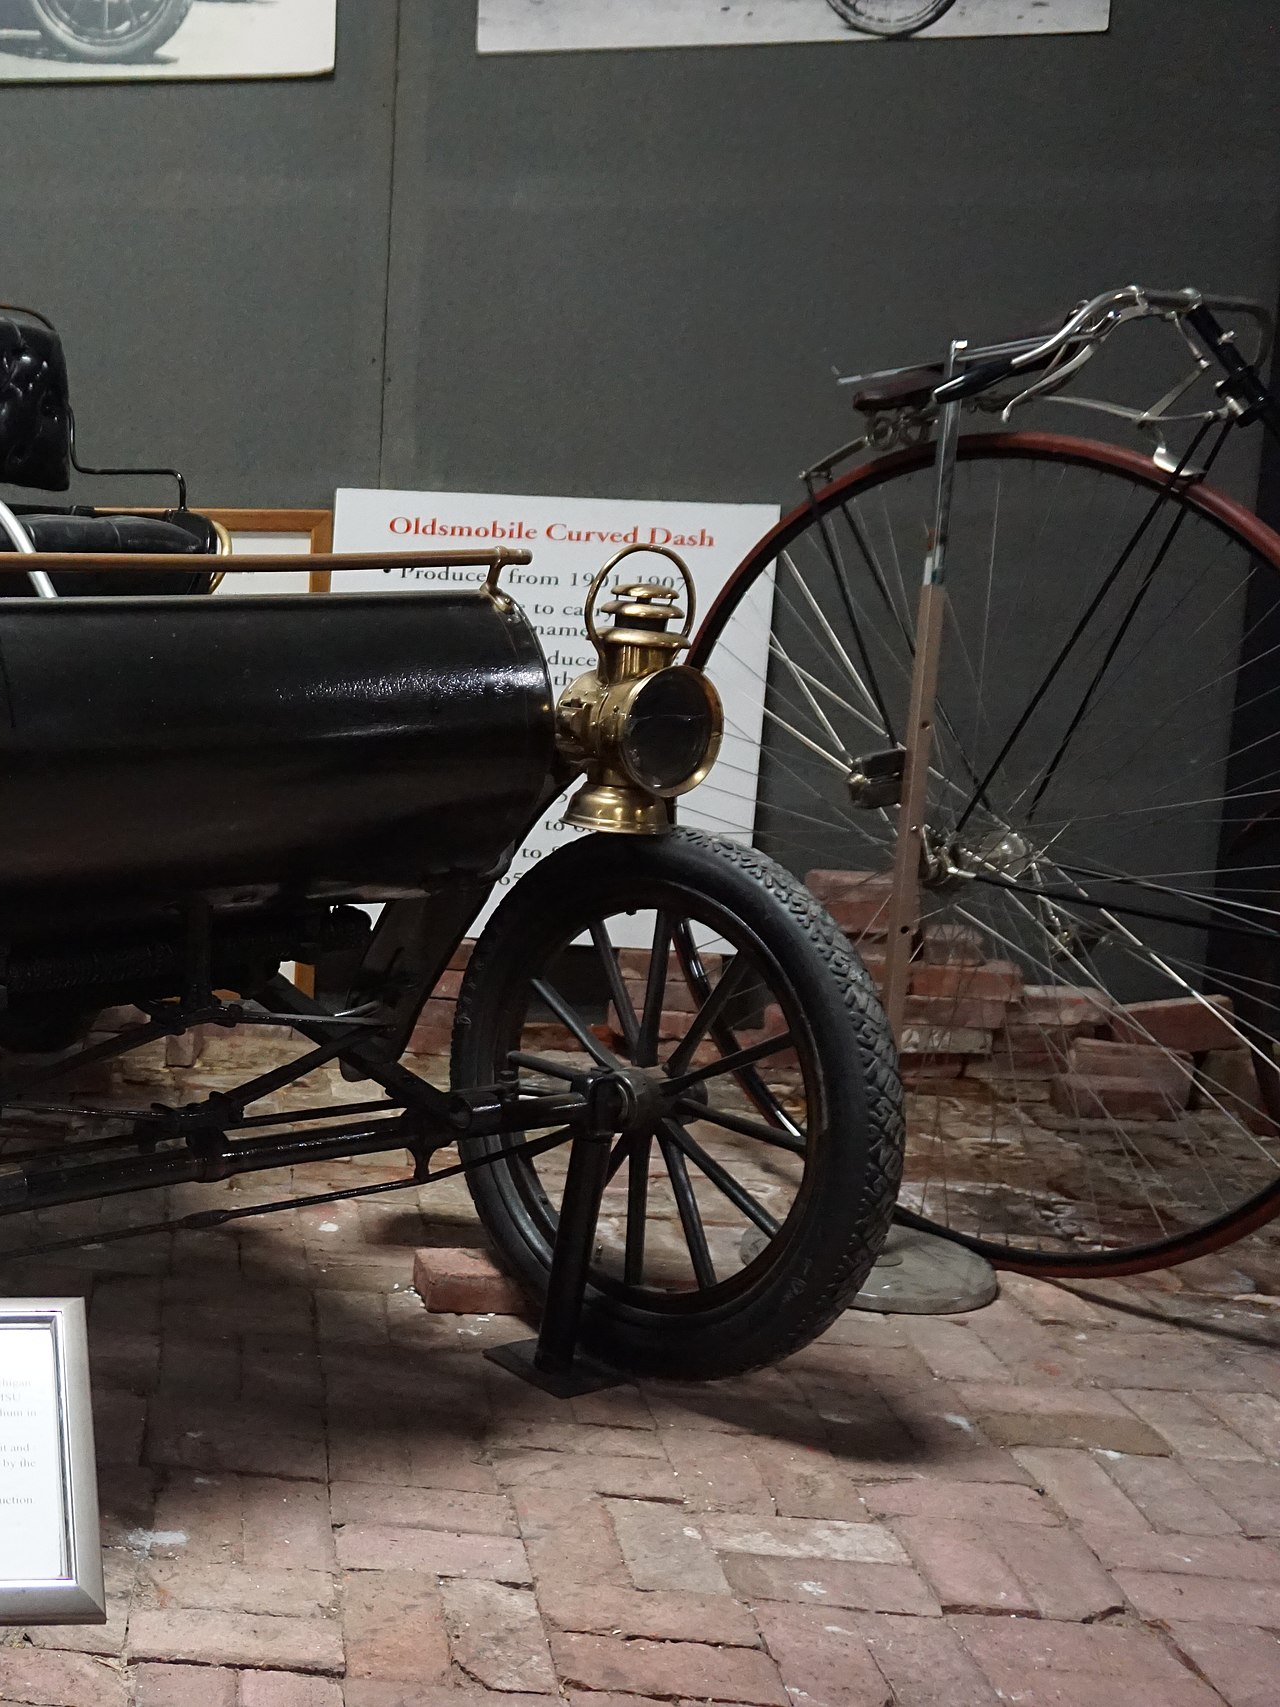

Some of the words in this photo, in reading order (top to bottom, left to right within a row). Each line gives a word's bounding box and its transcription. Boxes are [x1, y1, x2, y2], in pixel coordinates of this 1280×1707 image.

[389, 516, 538, 541] Oldsmobile
[545, 523, 638, 544] Curved
[648, 526, 715, 548] Dash
[400, 567, 488, 582] Produce
[508, 568, 559, 586] from
[534, 603, 555, 615] to
[545, 820, 566, 832] to
[522, 848, 542, 859] to
[26, 1408, 37, 1417] in
[0, 1443, 7, 1453] it
[10, 1443, 30, 1453] and
[3, 1459, 15, 1470] by
[19, 1459, 36, 1468] the
